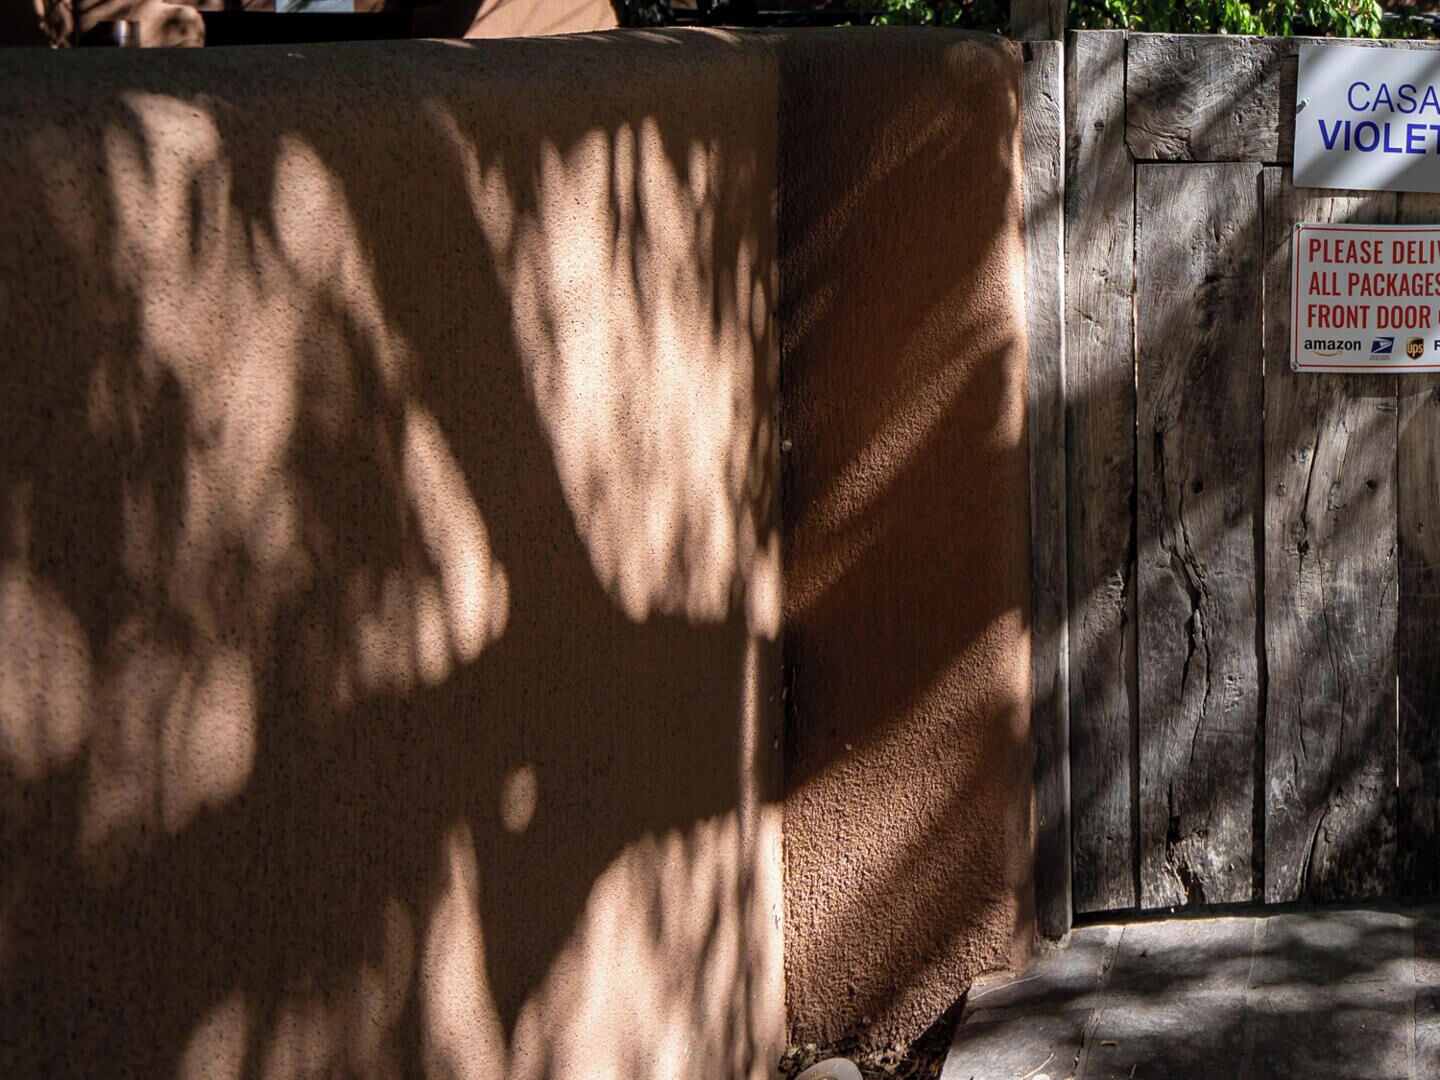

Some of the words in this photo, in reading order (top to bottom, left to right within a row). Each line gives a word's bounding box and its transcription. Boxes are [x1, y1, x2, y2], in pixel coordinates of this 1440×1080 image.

[1308, 238, 1384, 264] PLEASE
[1308, 271, 1341, 296] ALL
[1307, 304, 1370, 329] FRONT
[1377, 305, 1431, 329] DOOR
[1304, 339, 1362, 351] amazon
[1407, 343, 1424, 357] ups
